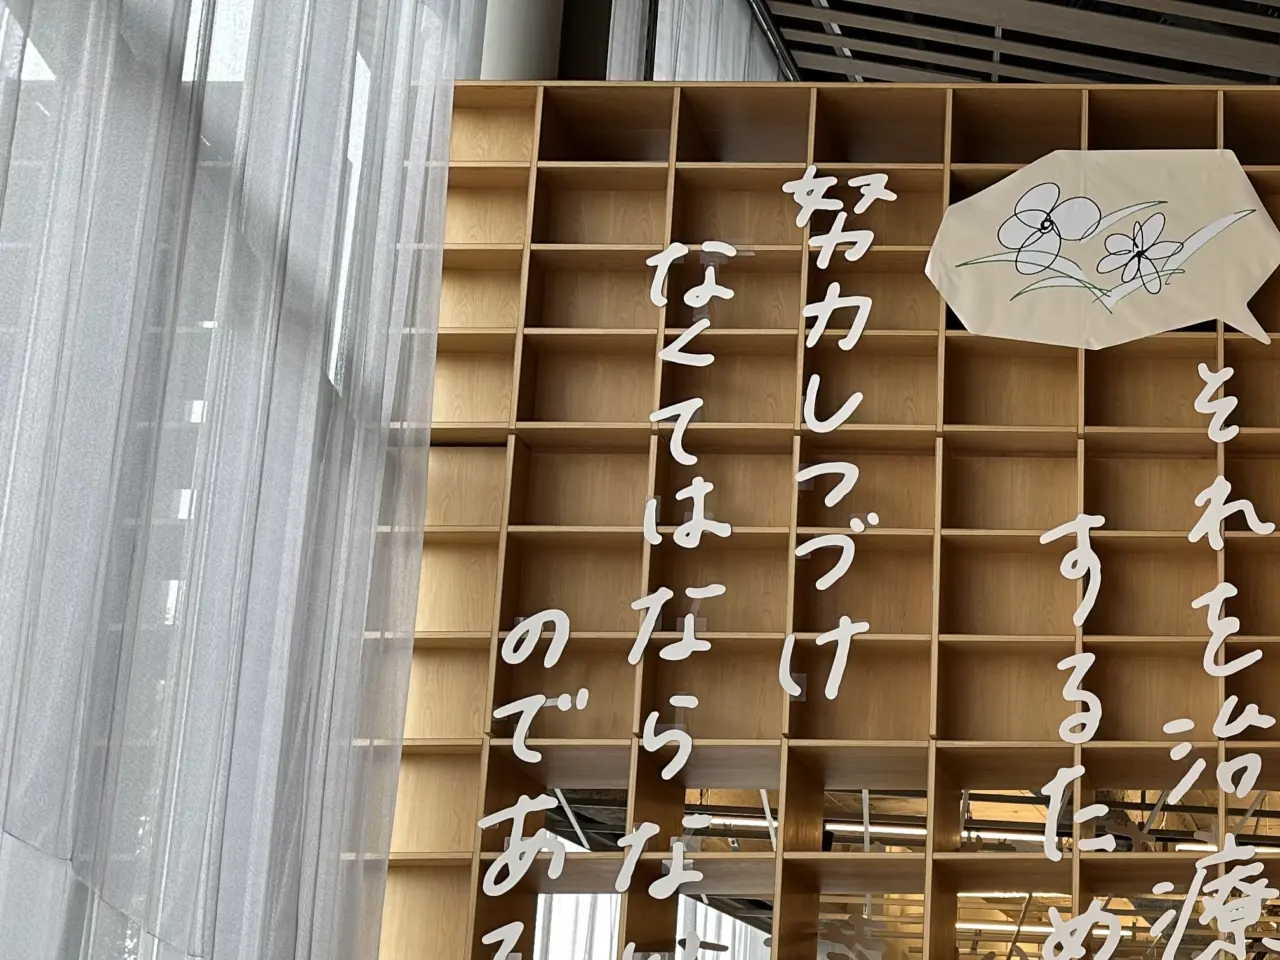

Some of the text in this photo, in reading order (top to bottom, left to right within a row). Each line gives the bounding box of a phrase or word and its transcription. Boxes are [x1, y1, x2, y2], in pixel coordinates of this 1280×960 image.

[782, 168, 898, 701] 努力しつづけ
